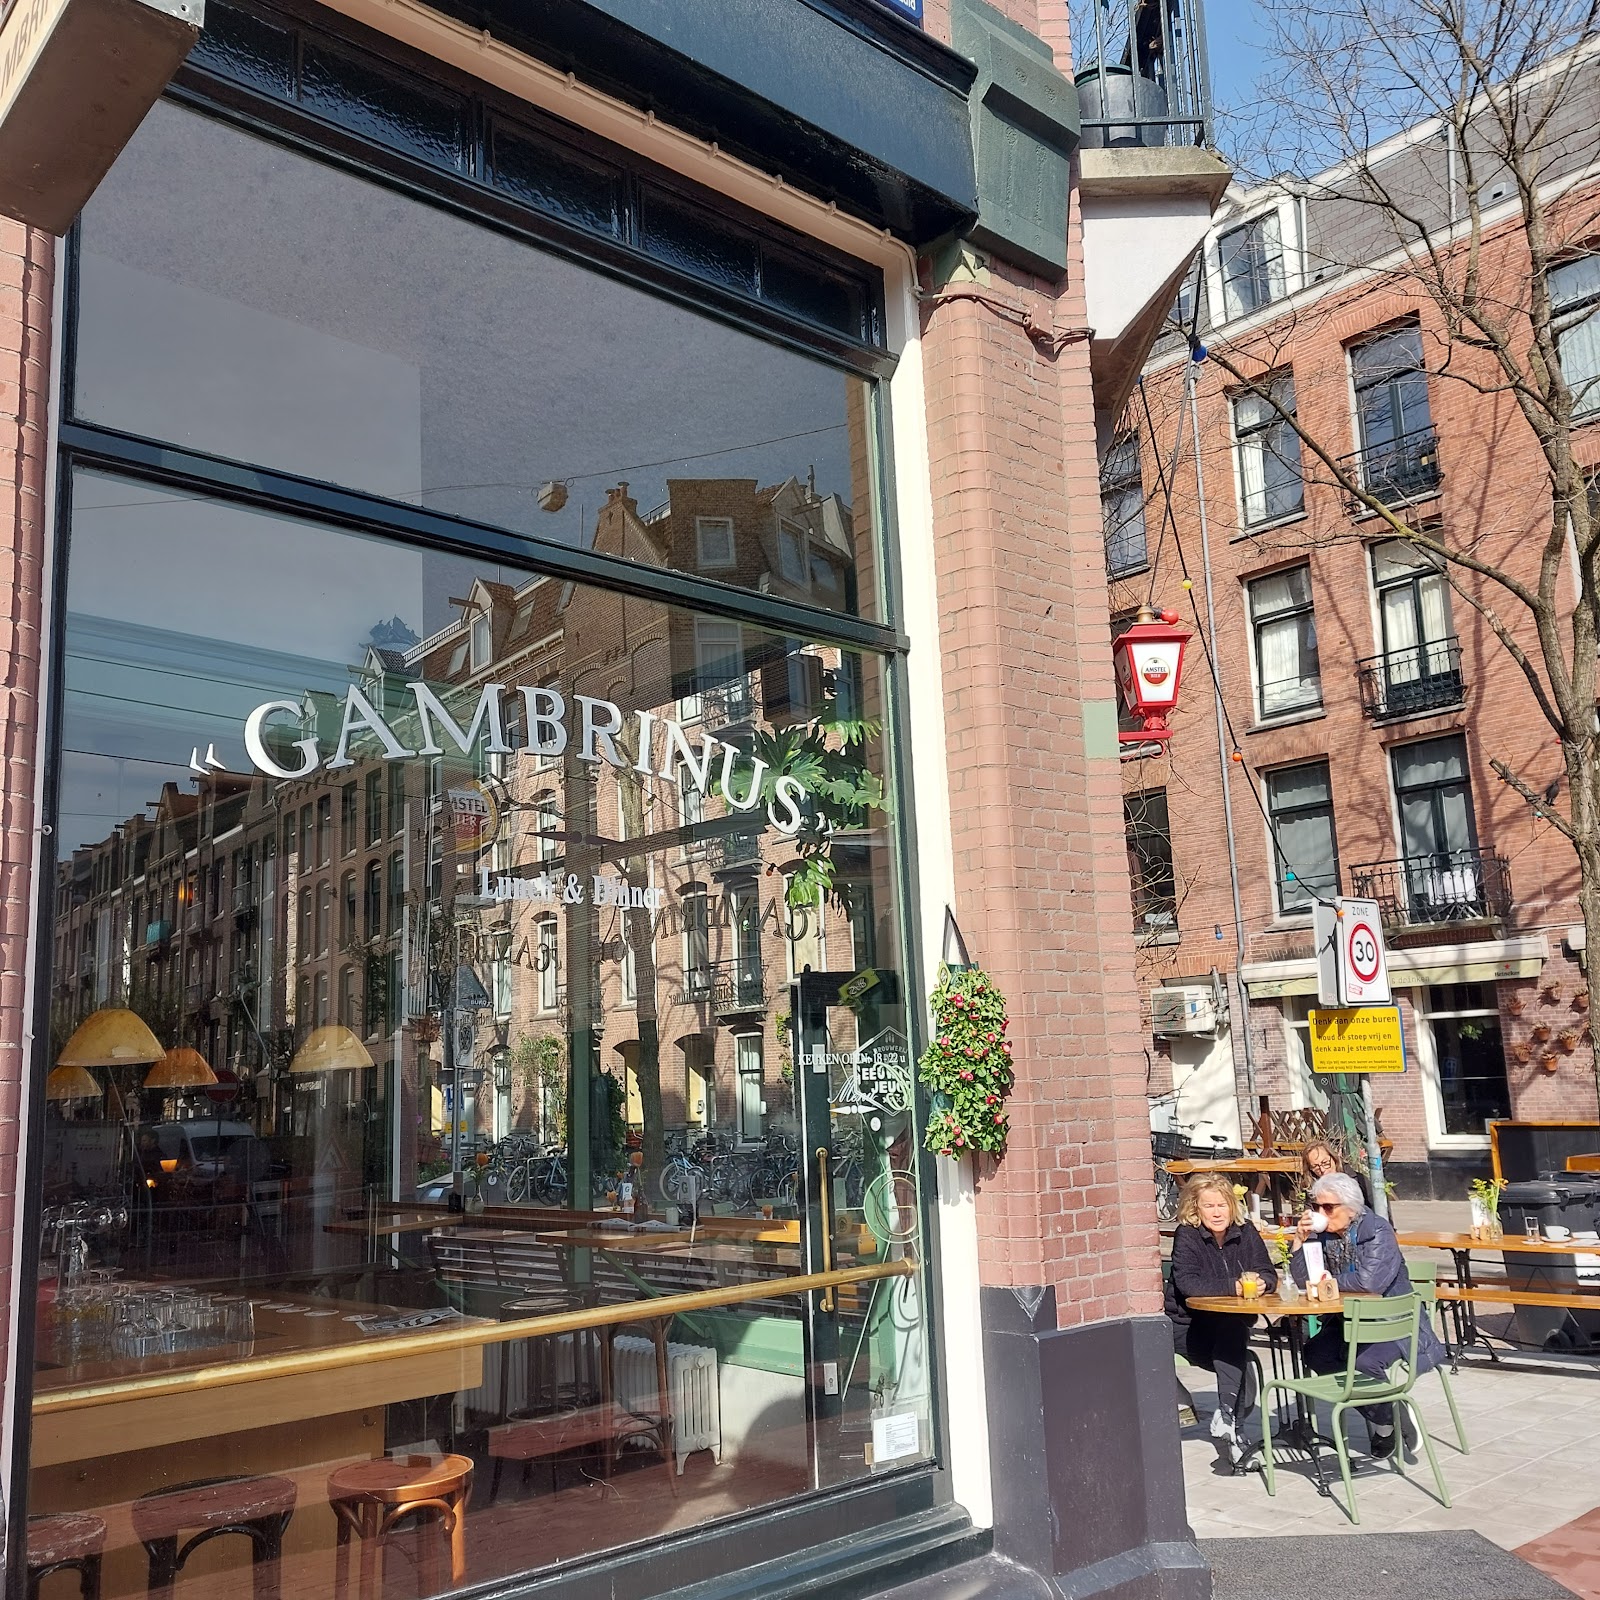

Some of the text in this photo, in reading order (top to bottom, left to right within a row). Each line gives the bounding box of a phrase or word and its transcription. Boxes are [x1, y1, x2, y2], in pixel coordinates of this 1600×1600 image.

[479, 867, 664, 909] Lunch & Dinner
[1352, 906, 1369, 917] ZONE
[1355, 941, 1375, 962] 30
[1312, 1017, 1332, 1025] Denk
[1351, 1016, 1370, 1024] onze
[1348, 1033, 1367, 1041] stoep
[1369, 1032, 1381, 1041] vrij
[1347, 1045, 1354, 1053] je
[1356, 1044, 1399, 1052] stemvolume
[798, 1053, 839, 1066] KEUKEN
[889, 1052, 899, 1063] 22
